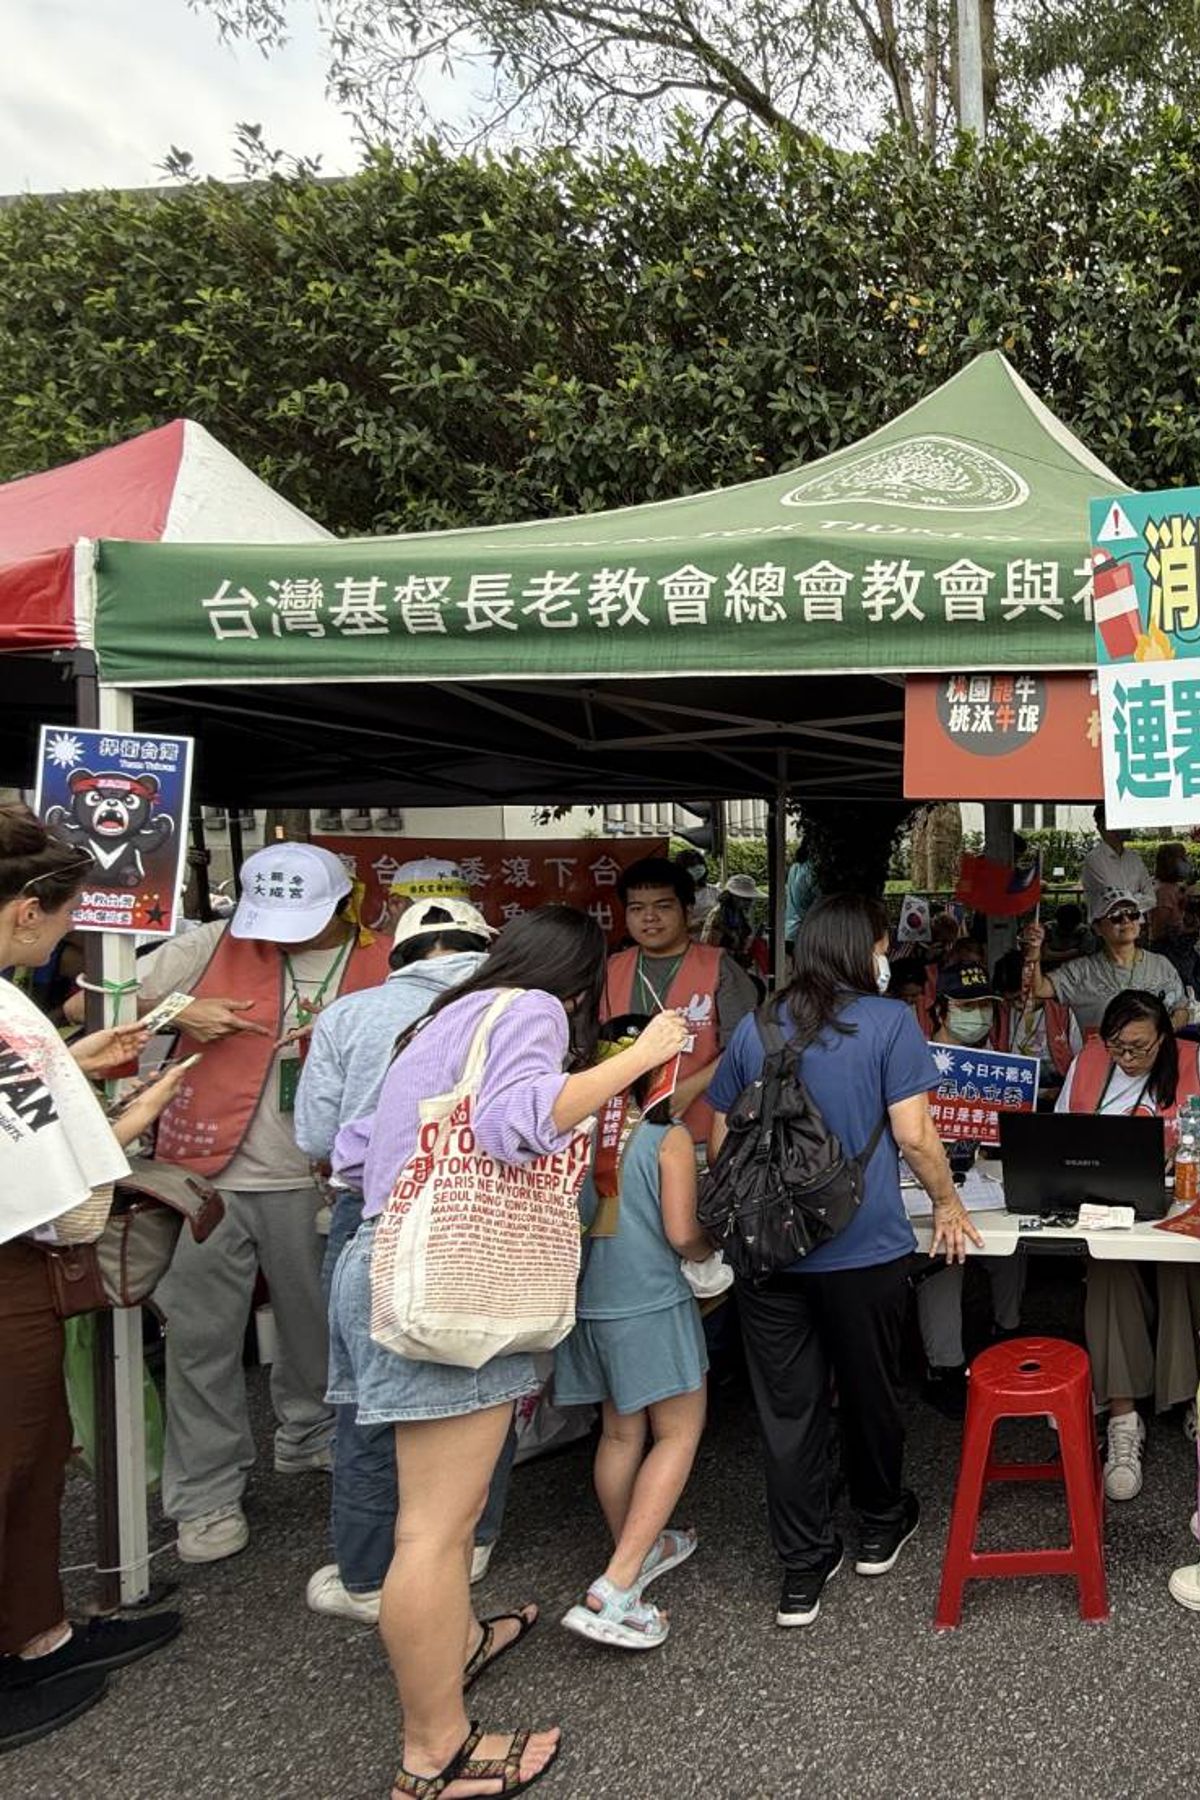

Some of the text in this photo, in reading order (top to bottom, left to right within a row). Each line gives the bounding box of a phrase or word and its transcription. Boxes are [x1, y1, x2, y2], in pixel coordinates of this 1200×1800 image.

[437, 1156, 494, 1177] TOKYO
[498, 1164, 560, 1192] ANTWERP
[433, 1176, 474, 1191] PARIS
[433, 1190, 472, 1205] SEOUL
